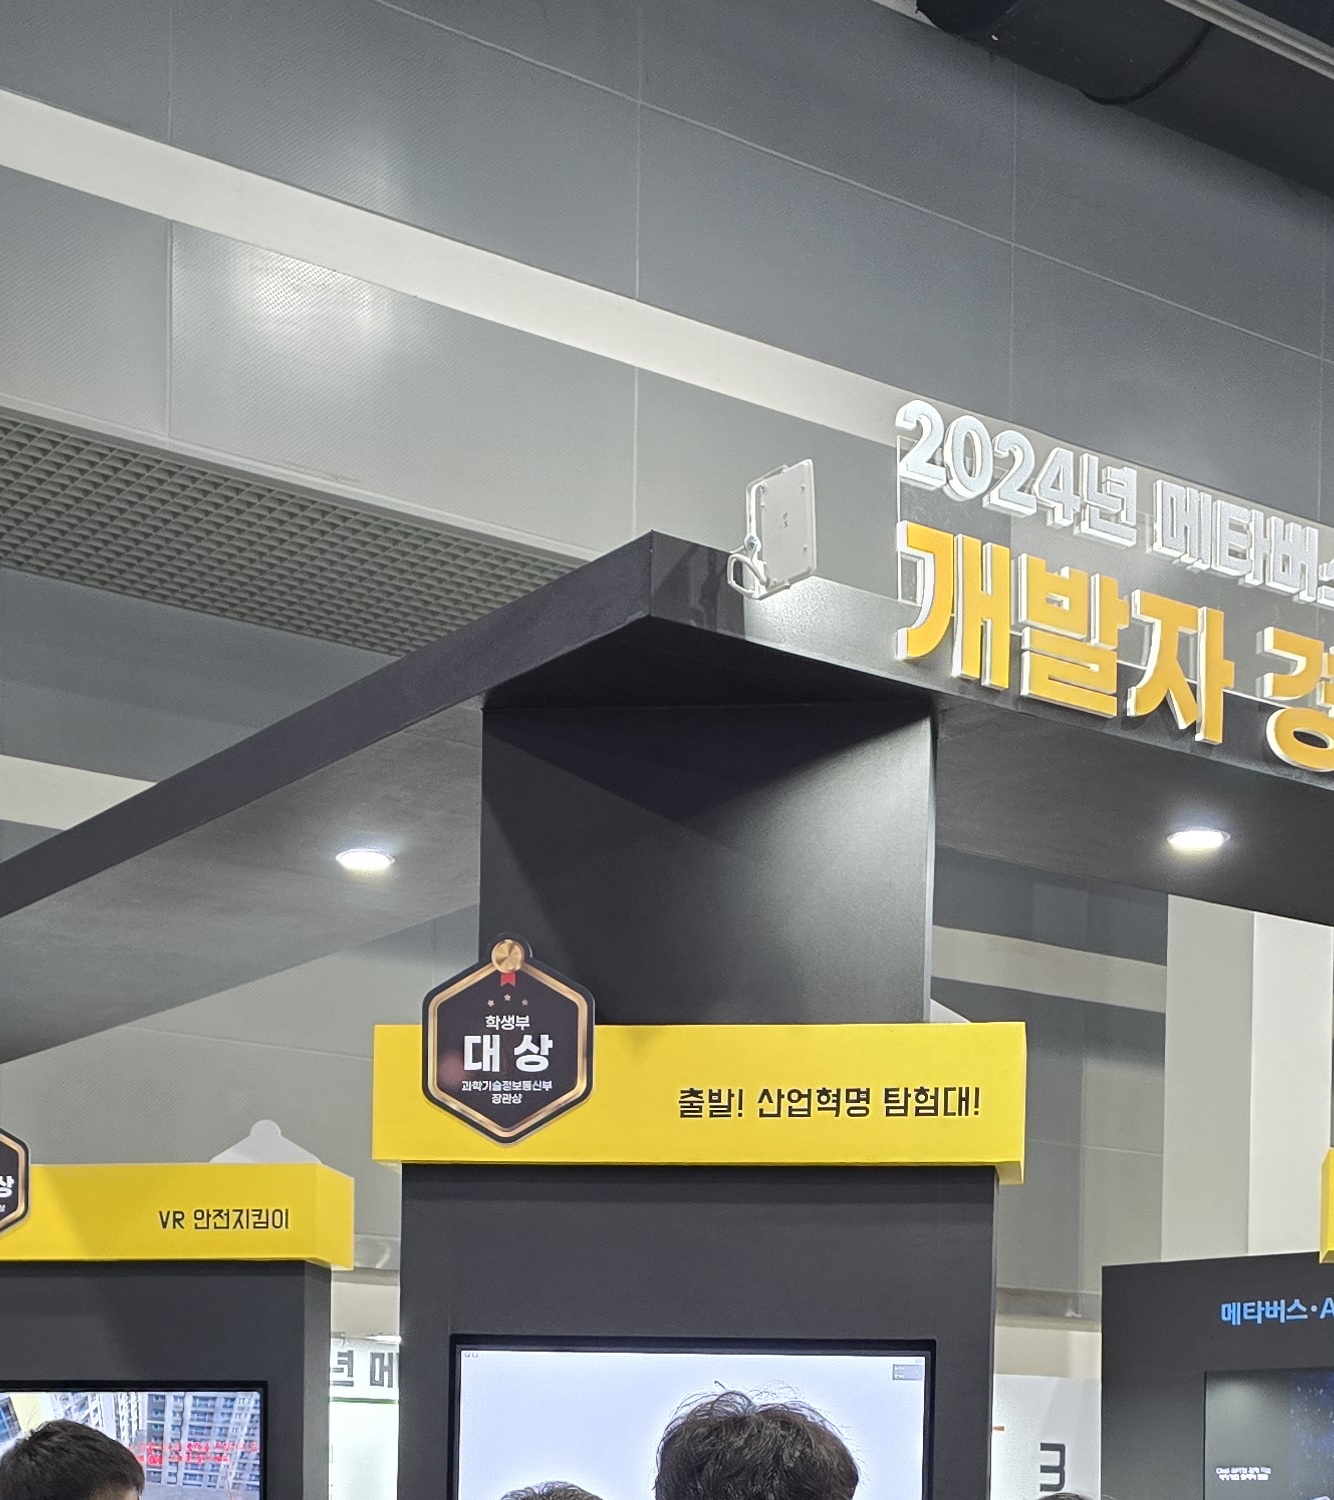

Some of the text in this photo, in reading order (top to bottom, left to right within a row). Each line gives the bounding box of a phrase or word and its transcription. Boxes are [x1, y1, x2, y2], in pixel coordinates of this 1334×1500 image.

[894, 398, 1138, 547] 2024년
[895, 519, 1234, 745] 개발자
[485, 1015, 530, 1031] 학생부
[462, 1080, 553, 1091] 과학기술정보통신부
[491, 1093, 523, 1104] 장관상
[678, 1086, 982, 1119] 출발! 산업혁명 탐험대!
[158, 1208, 290, 1231] VR 안전지킴이
